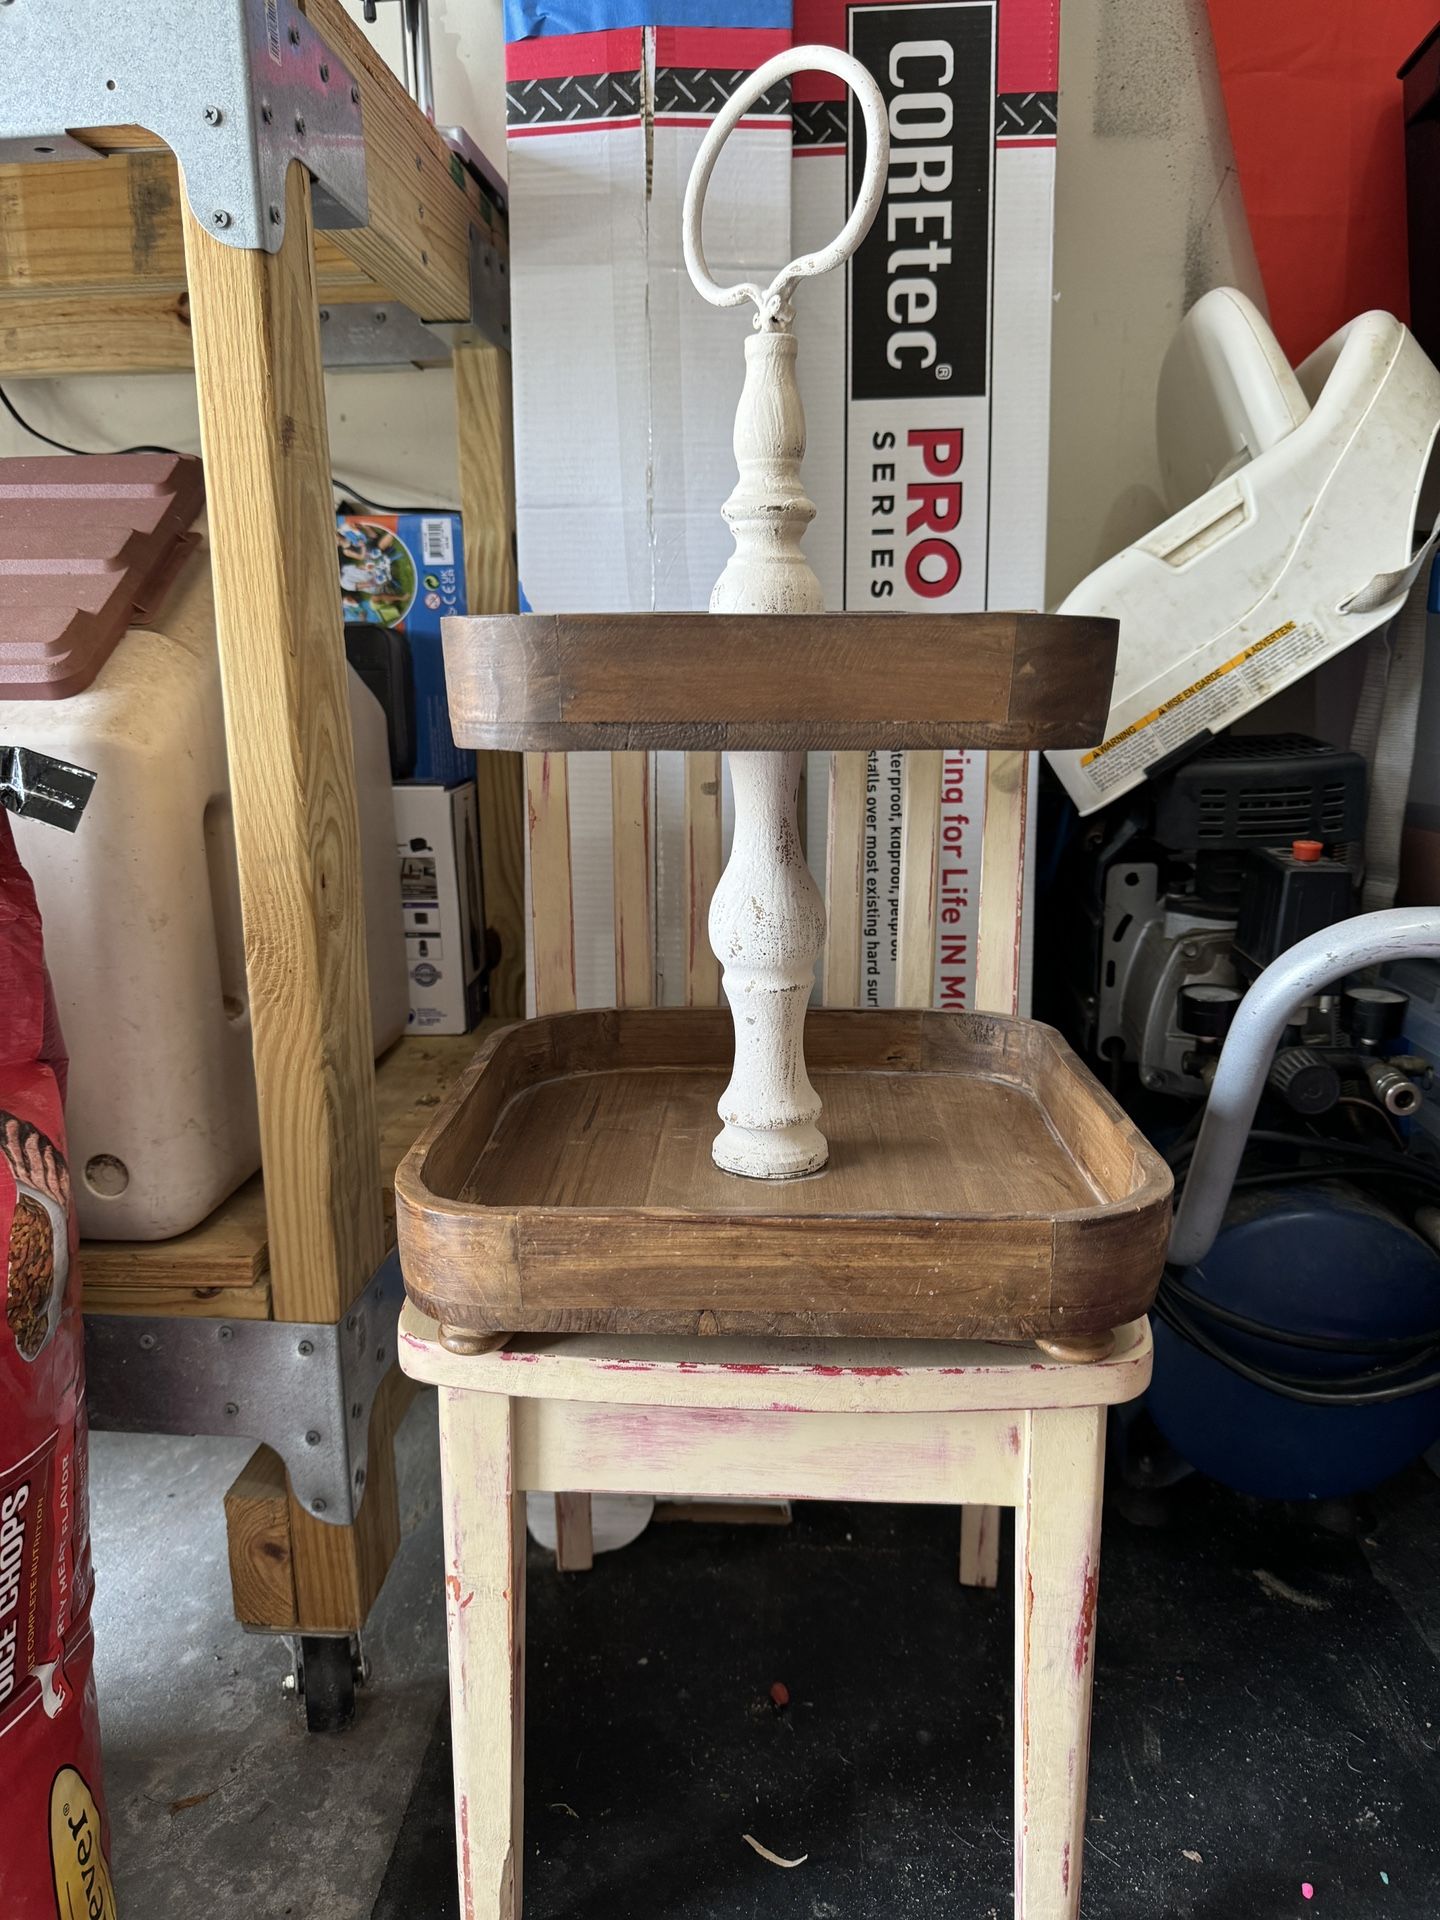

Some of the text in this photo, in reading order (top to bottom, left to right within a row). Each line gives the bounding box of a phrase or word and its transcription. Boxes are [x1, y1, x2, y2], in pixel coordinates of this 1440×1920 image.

[871, 431, 896, 598] SERIES
[904, 428, 964, 599] PRO
[1194, 668, 1224, 690] GARDE
[1100, 725, 1137, 756] WARNING
[866, 797, 877, 832] over
[943, 814, 969, 859] for
[866, 835, 879, 874] most
[864, 877, 880, 937] existing
[942, 869, 968, 924] Life
[866, 941, 880, 975] hard
[941, 935, 967, 964] IN
[60, 1453, 69, 1537] FLAVOR
[0, 1485, 29, 1619] CHOPS
[30, 1497, 44, 1578] NUTRITION
[58, 1541, 68, 1594] MEAT
[27, 1578, 38, 1651] COMPLETE
